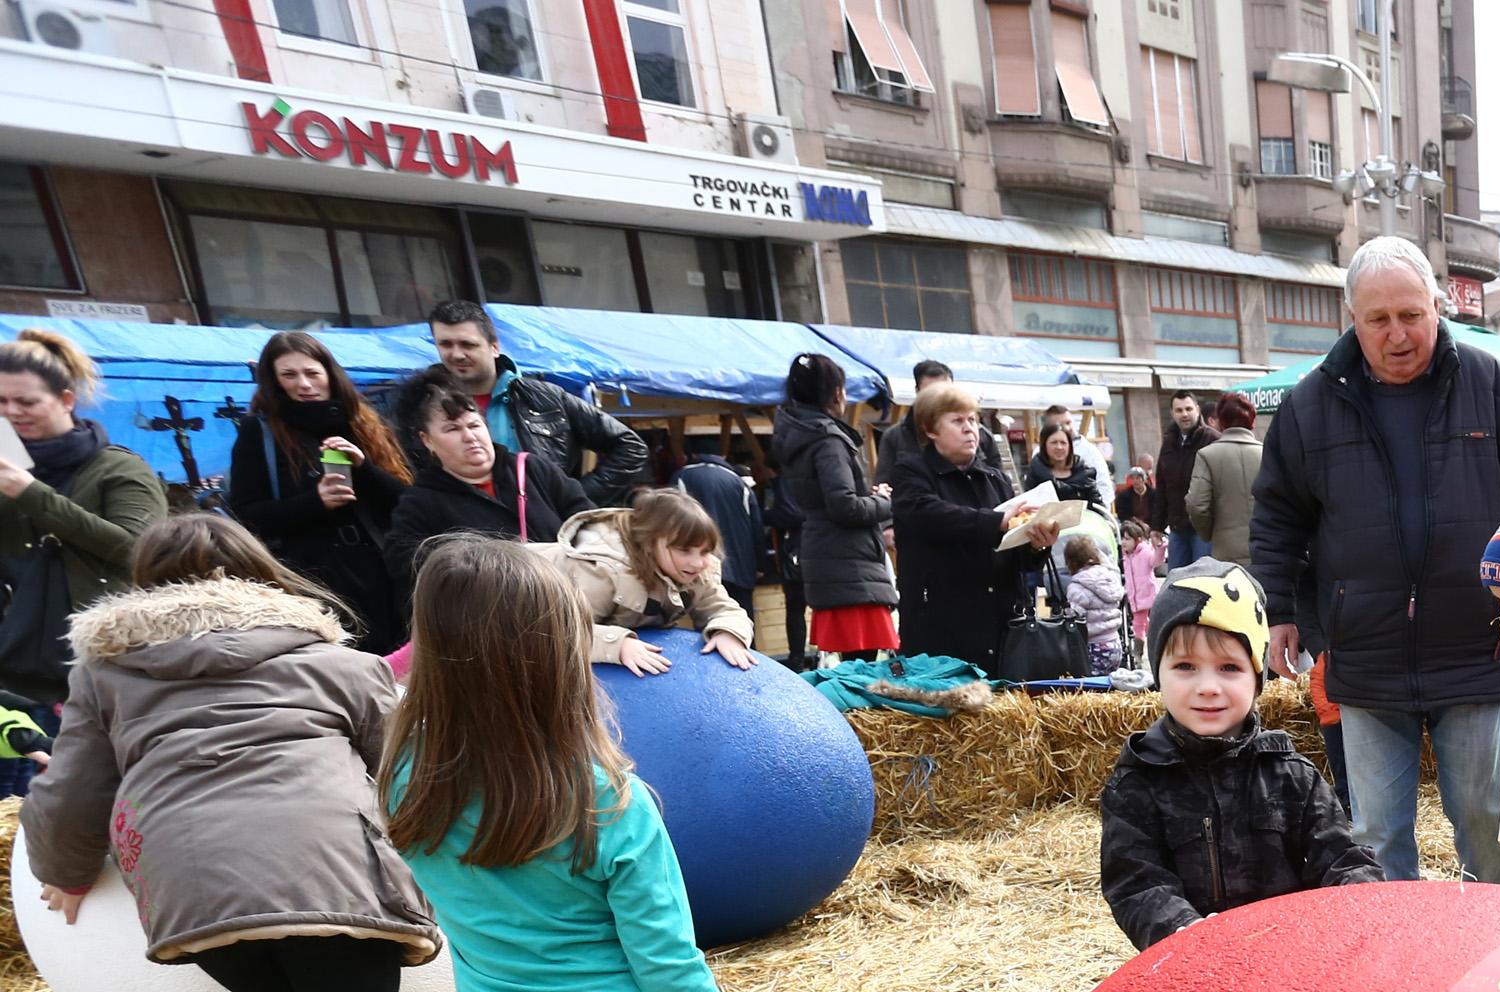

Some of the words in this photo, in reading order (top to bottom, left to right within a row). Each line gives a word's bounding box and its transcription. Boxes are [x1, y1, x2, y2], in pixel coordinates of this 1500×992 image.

[240, 97, 519, 184] KONZUM
[689, 174, 789, 200] TRGOVAČKI
[693, 194, 793, 217] CENTAR
